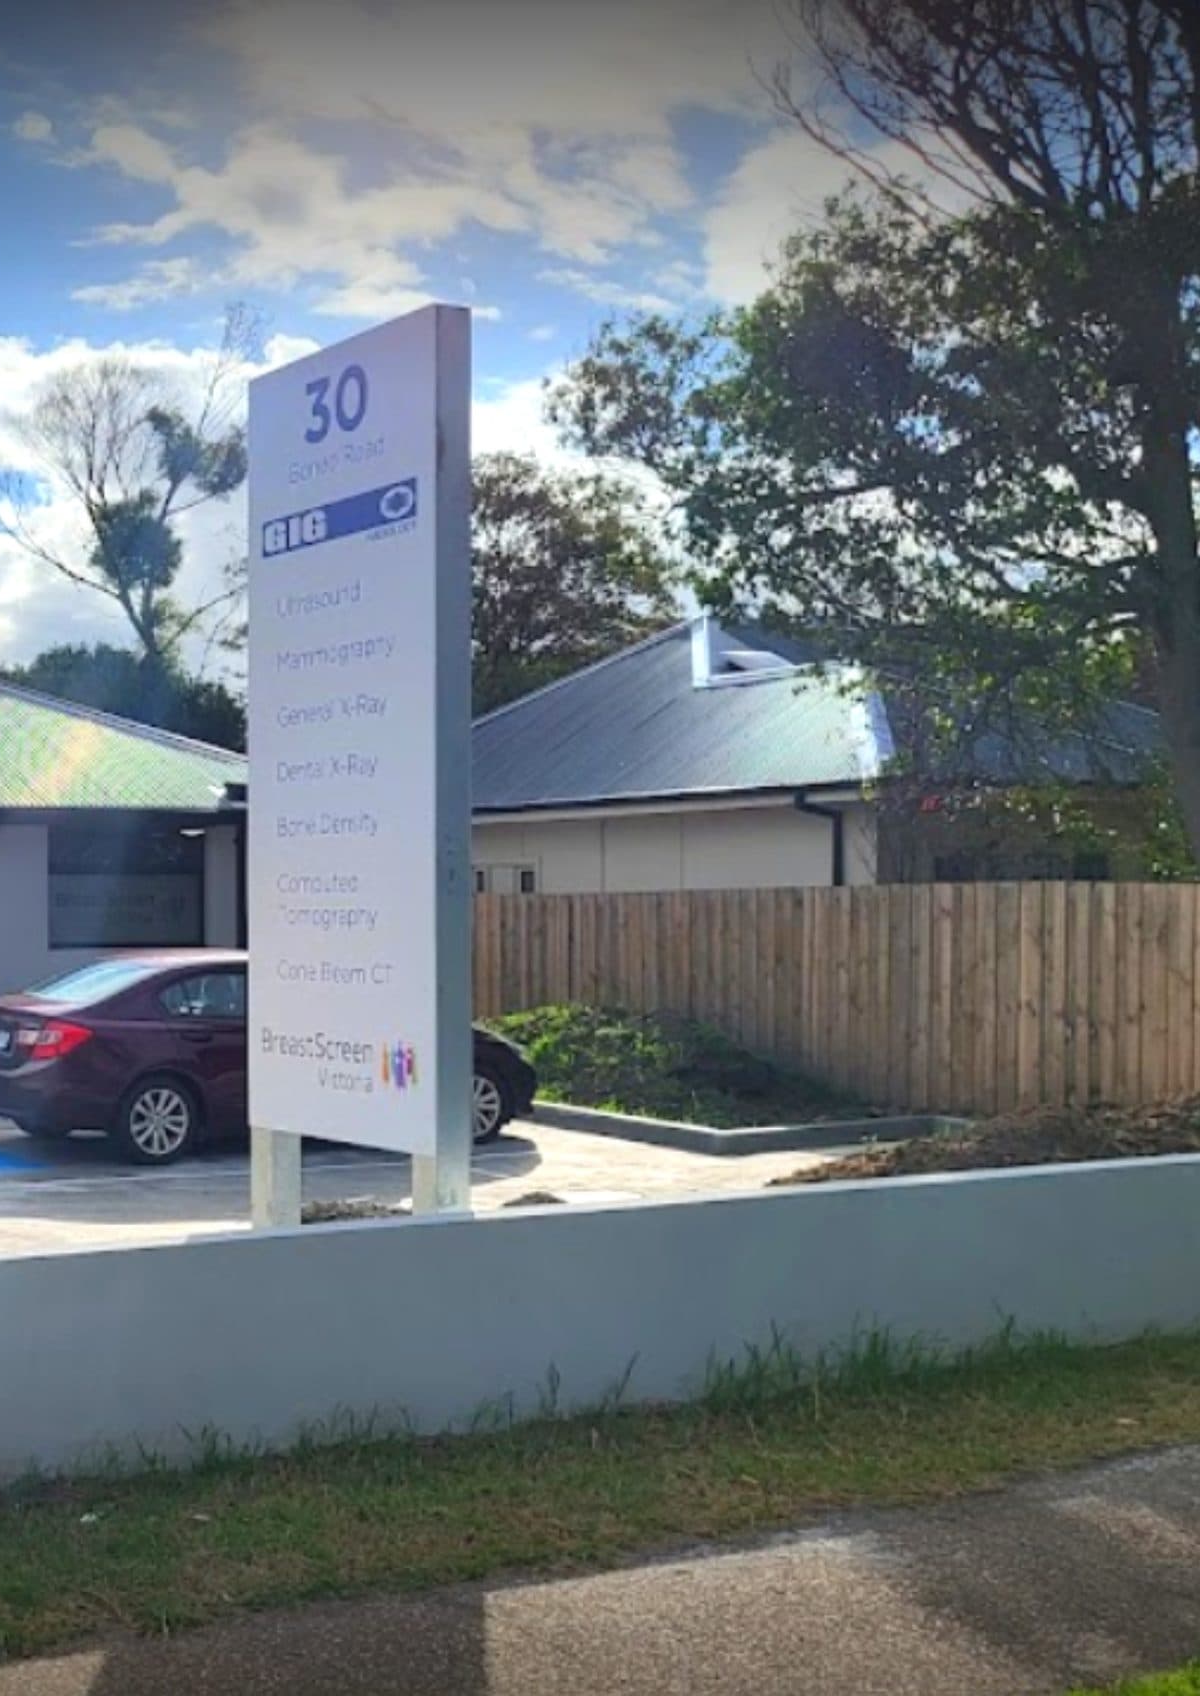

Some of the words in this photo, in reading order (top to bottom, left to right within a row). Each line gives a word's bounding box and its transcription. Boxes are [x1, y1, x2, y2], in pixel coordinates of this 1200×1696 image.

[304, 364, 368, 444] 30
[263, 507, 328, 555] GIG
[338, 693, 388, 717] X-Ray
[330, 753, 379, 778] X-Ray
[276, 816, 316, 838] Bone
[276, 959, 316, 982] Cone
[371, 963, 393, 985] CT
